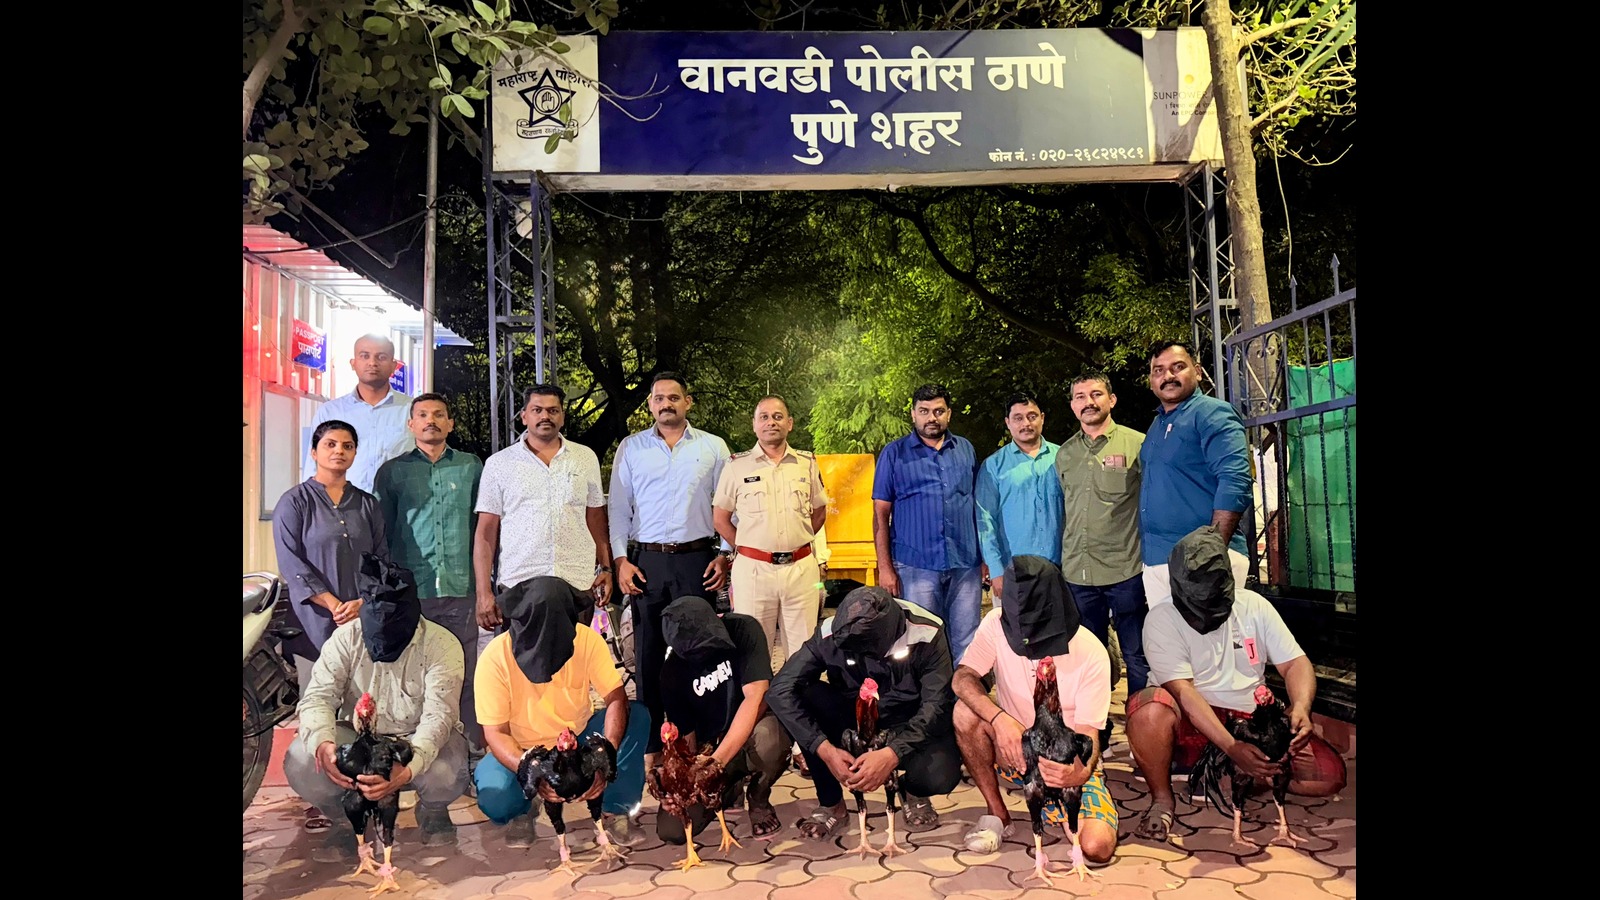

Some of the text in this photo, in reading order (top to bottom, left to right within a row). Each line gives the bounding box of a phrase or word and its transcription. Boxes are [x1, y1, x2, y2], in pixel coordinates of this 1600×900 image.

[678, 42, 1067, 93] वानवडी पोलीस ठाणे
[497, 70, 538, 88] महाराष्ट्र
[790, 99, 962, 165] पुणे शहर
[989, 148, 1012, 162] फोन
[295, 326, 324, 346] PASSPORT
